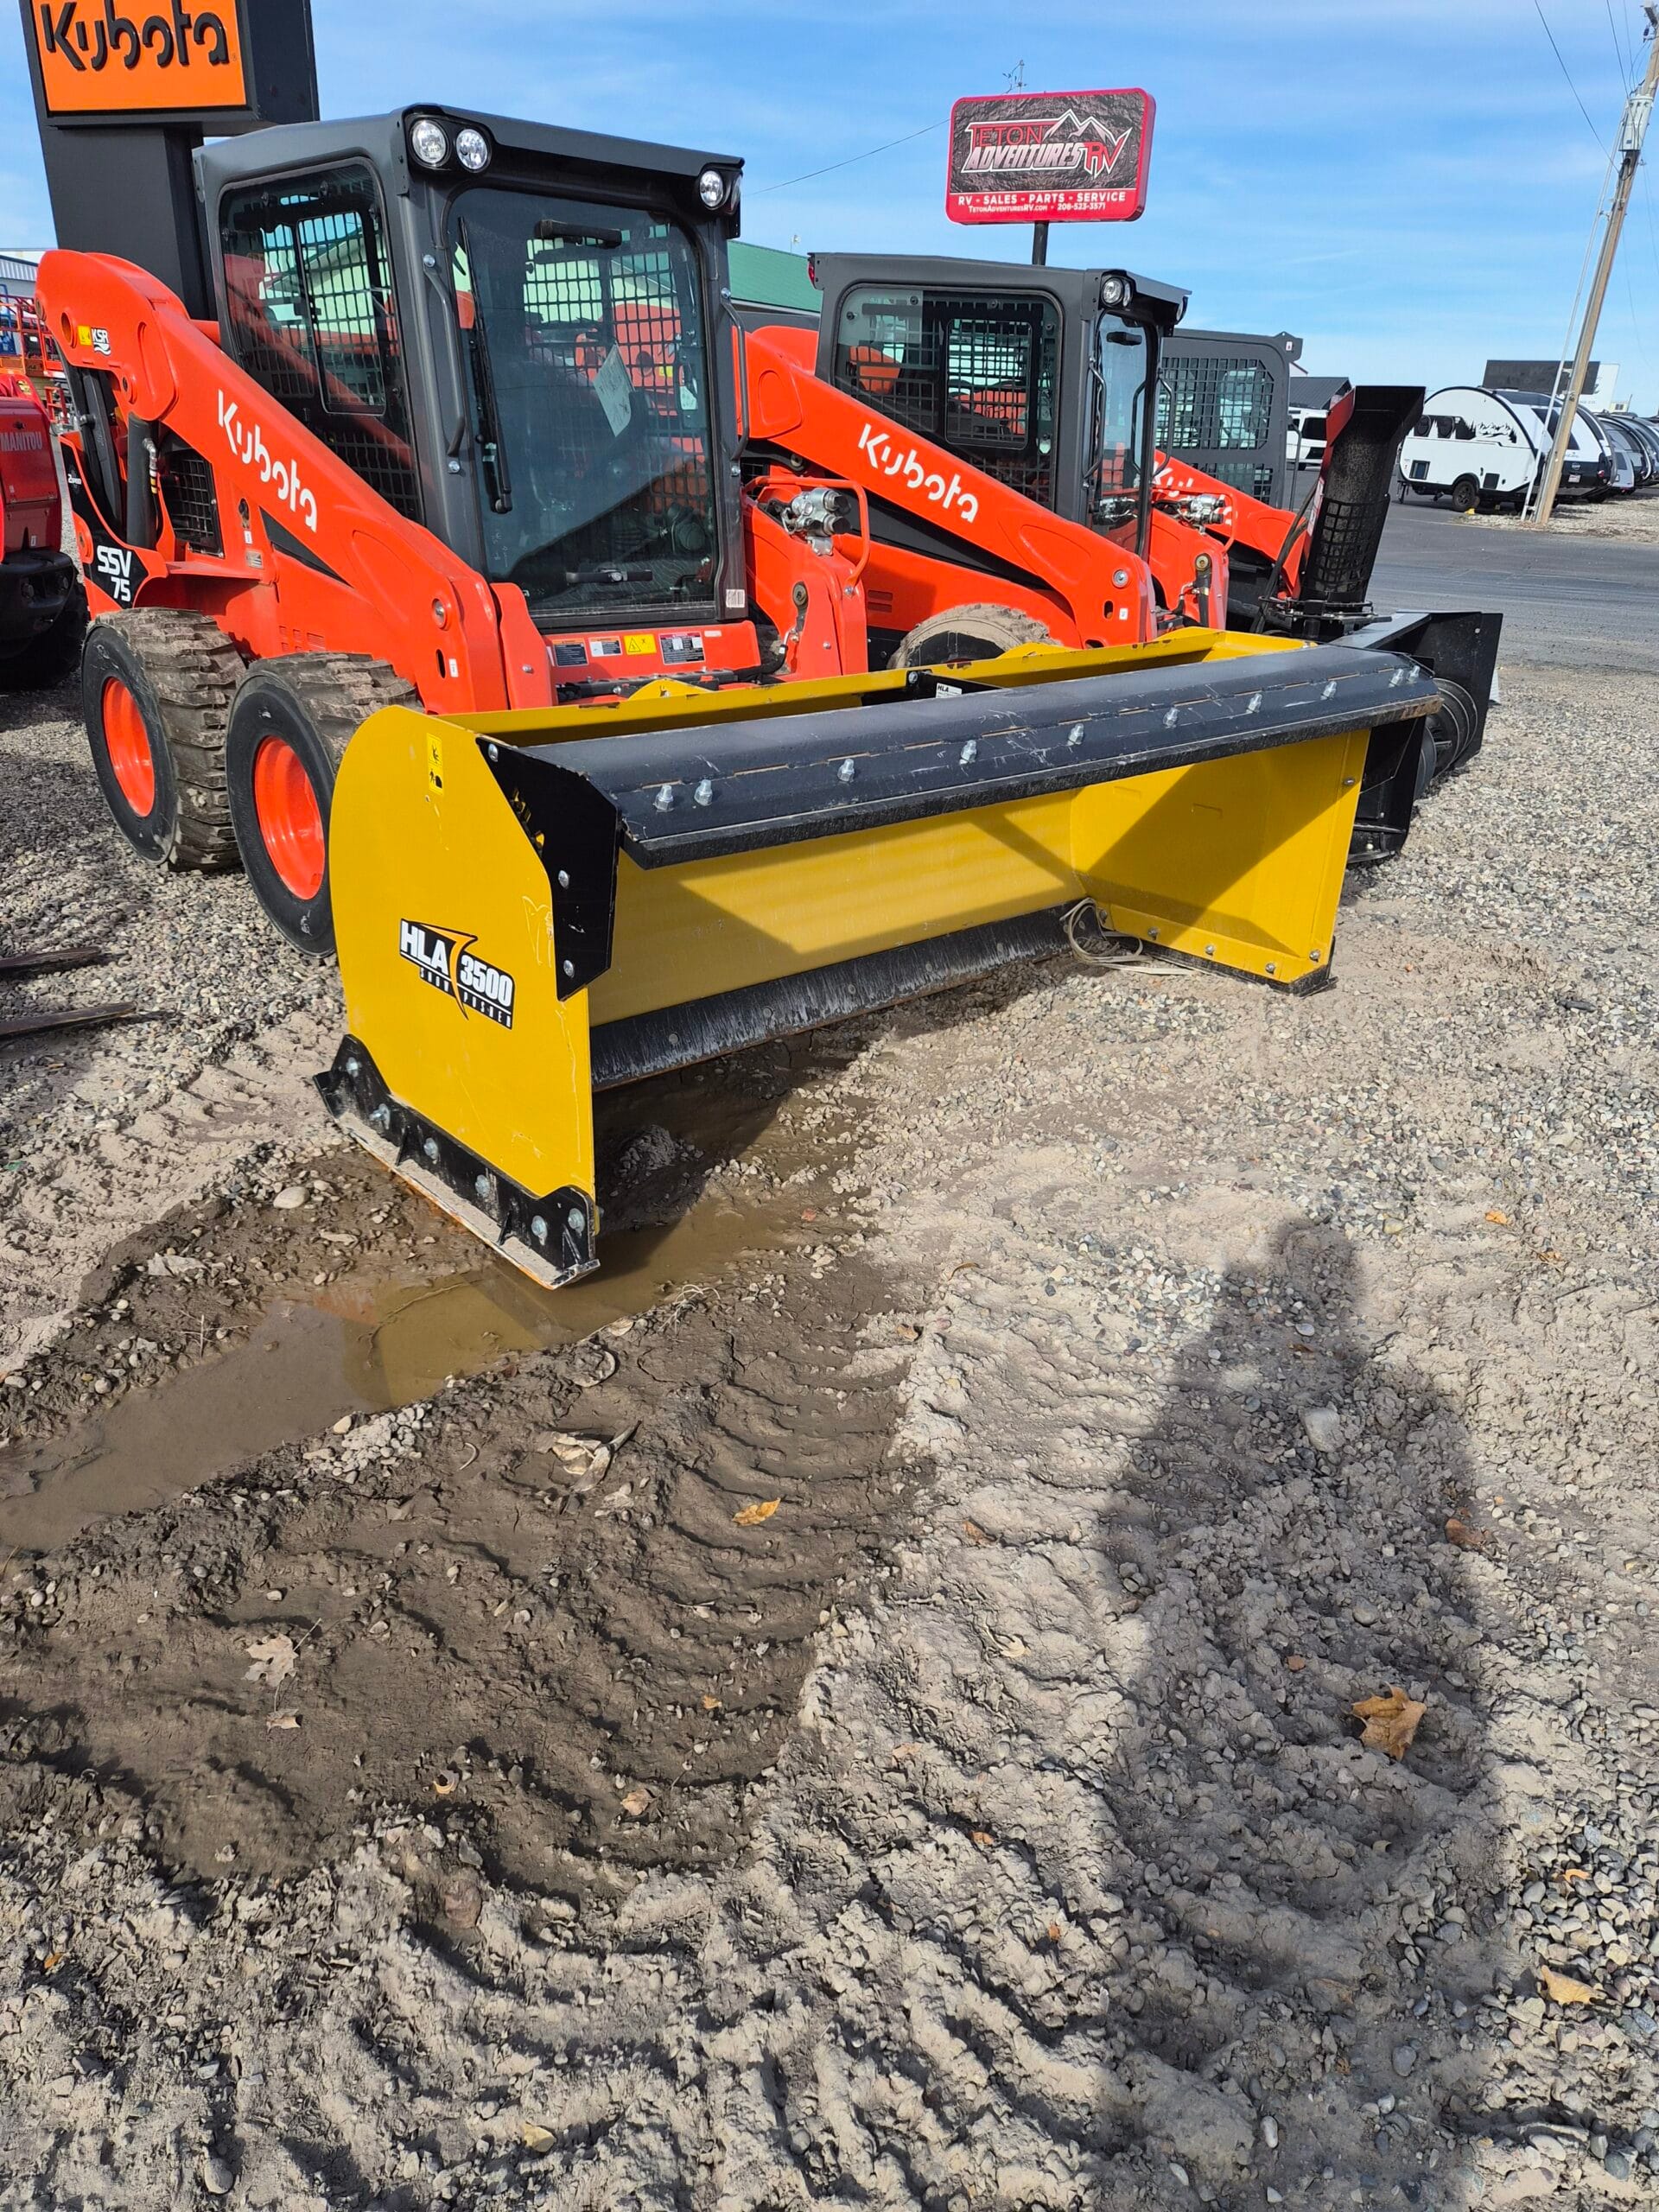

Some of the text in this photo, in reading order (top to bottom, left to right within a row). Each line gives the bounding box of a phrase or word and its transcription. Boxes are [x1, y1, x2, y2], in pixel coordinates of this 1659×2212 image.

[41, 0, 230, 71] Kubota
[968, 125, 1044, 148] TETON
[965, 137, 1125, 172] ADVENTURES RV
[958, 191, 1126, 206] RV SALES PARTS SERVICE
[0, 431, 42, 451] MANITOU
[218, 389, 318, 533] Kubota
[858, 423, 980, 524] Kubota
[97, 544, 131, 577] SSV
[111, 576, 130, 602] 75
[400, 919, 513, 1007] HLA 3500
